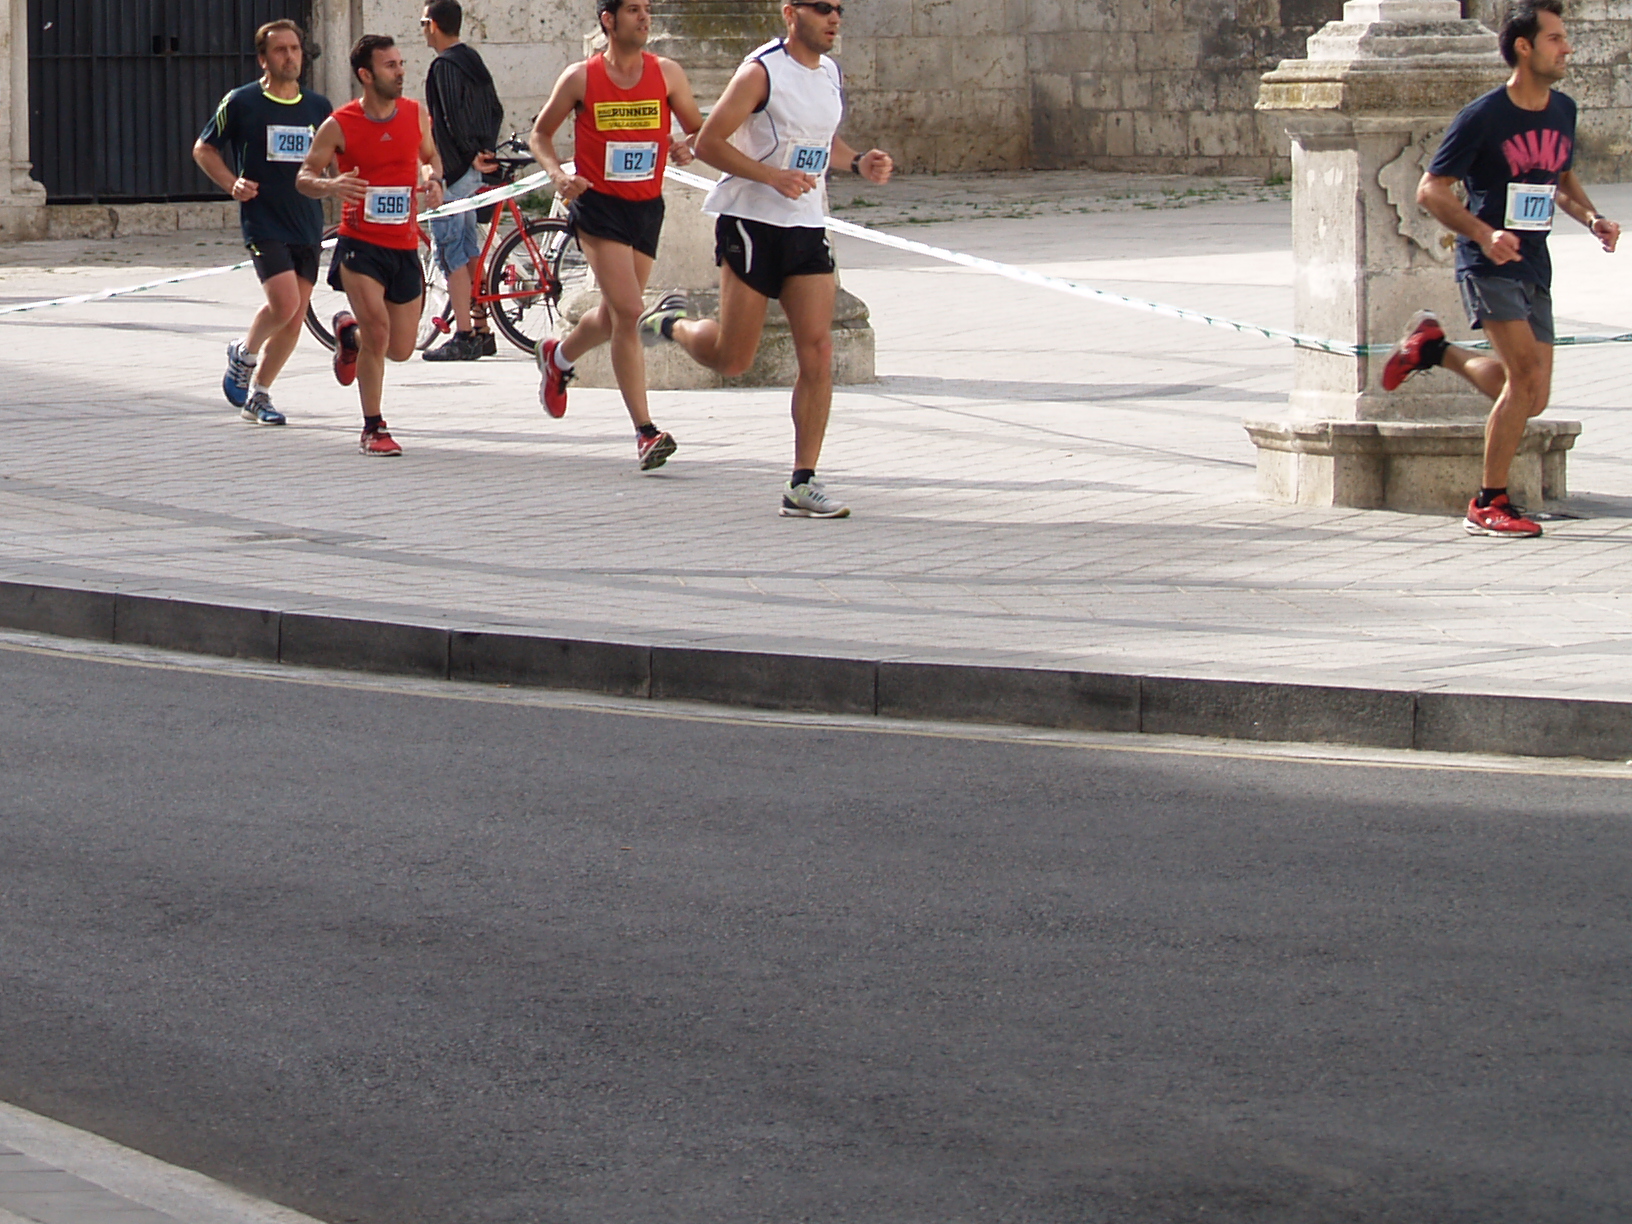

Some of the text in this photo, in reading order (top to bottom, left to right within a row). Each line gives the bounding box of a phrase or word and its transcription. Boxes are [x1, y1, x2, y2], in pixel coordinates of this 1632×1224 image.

[612, 106, 658, 117] RUNNERS
[279, 134, 304, 152] 298
[624, 152, 643, 171] 62
[796, 149, 822, 170] 647
[377, 196, 404, 214] 596
[1523, 196, 1545, 217] 177
